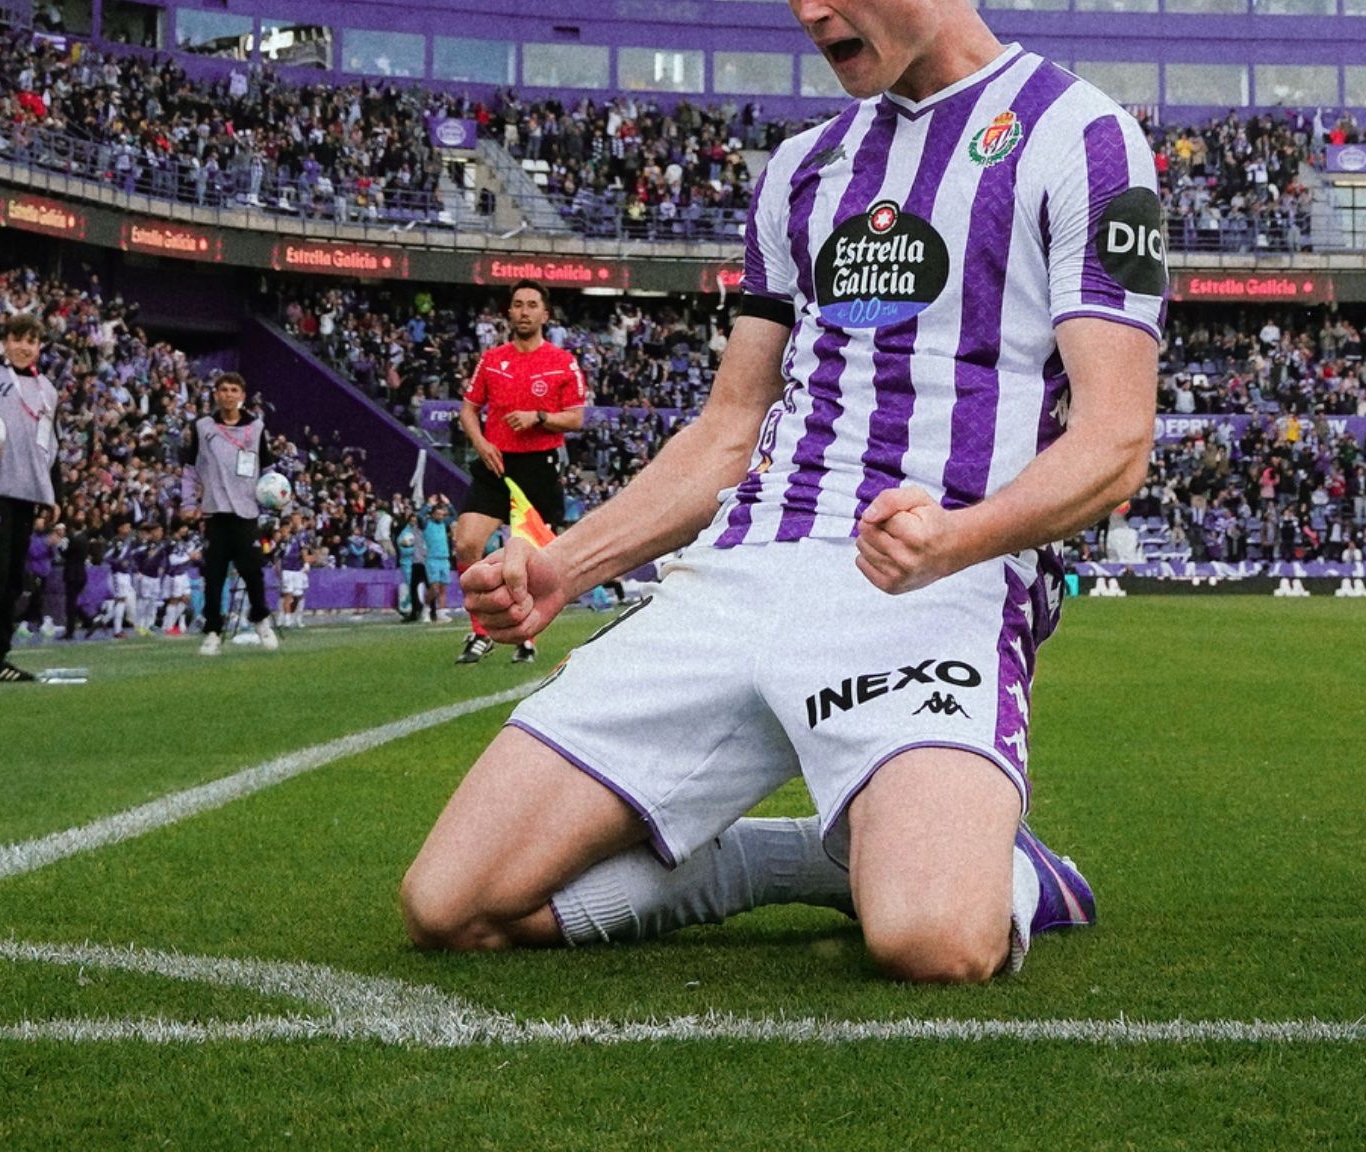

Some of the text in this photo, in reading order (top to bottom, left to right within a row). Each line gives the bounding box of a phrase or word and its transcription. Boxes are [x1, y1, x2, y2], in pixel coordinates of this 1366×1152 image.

[286, 246, 377, 269] Estrella Galicia
[833, 234, 925, 267] Estrella
[492, 261, 592, 280] Estrella Galicia
[832, 264, 916, 297] Galicia
[1190, 278, 1297, 294] Estrella Galicia
[805, 659, 982, 729] INEXO
